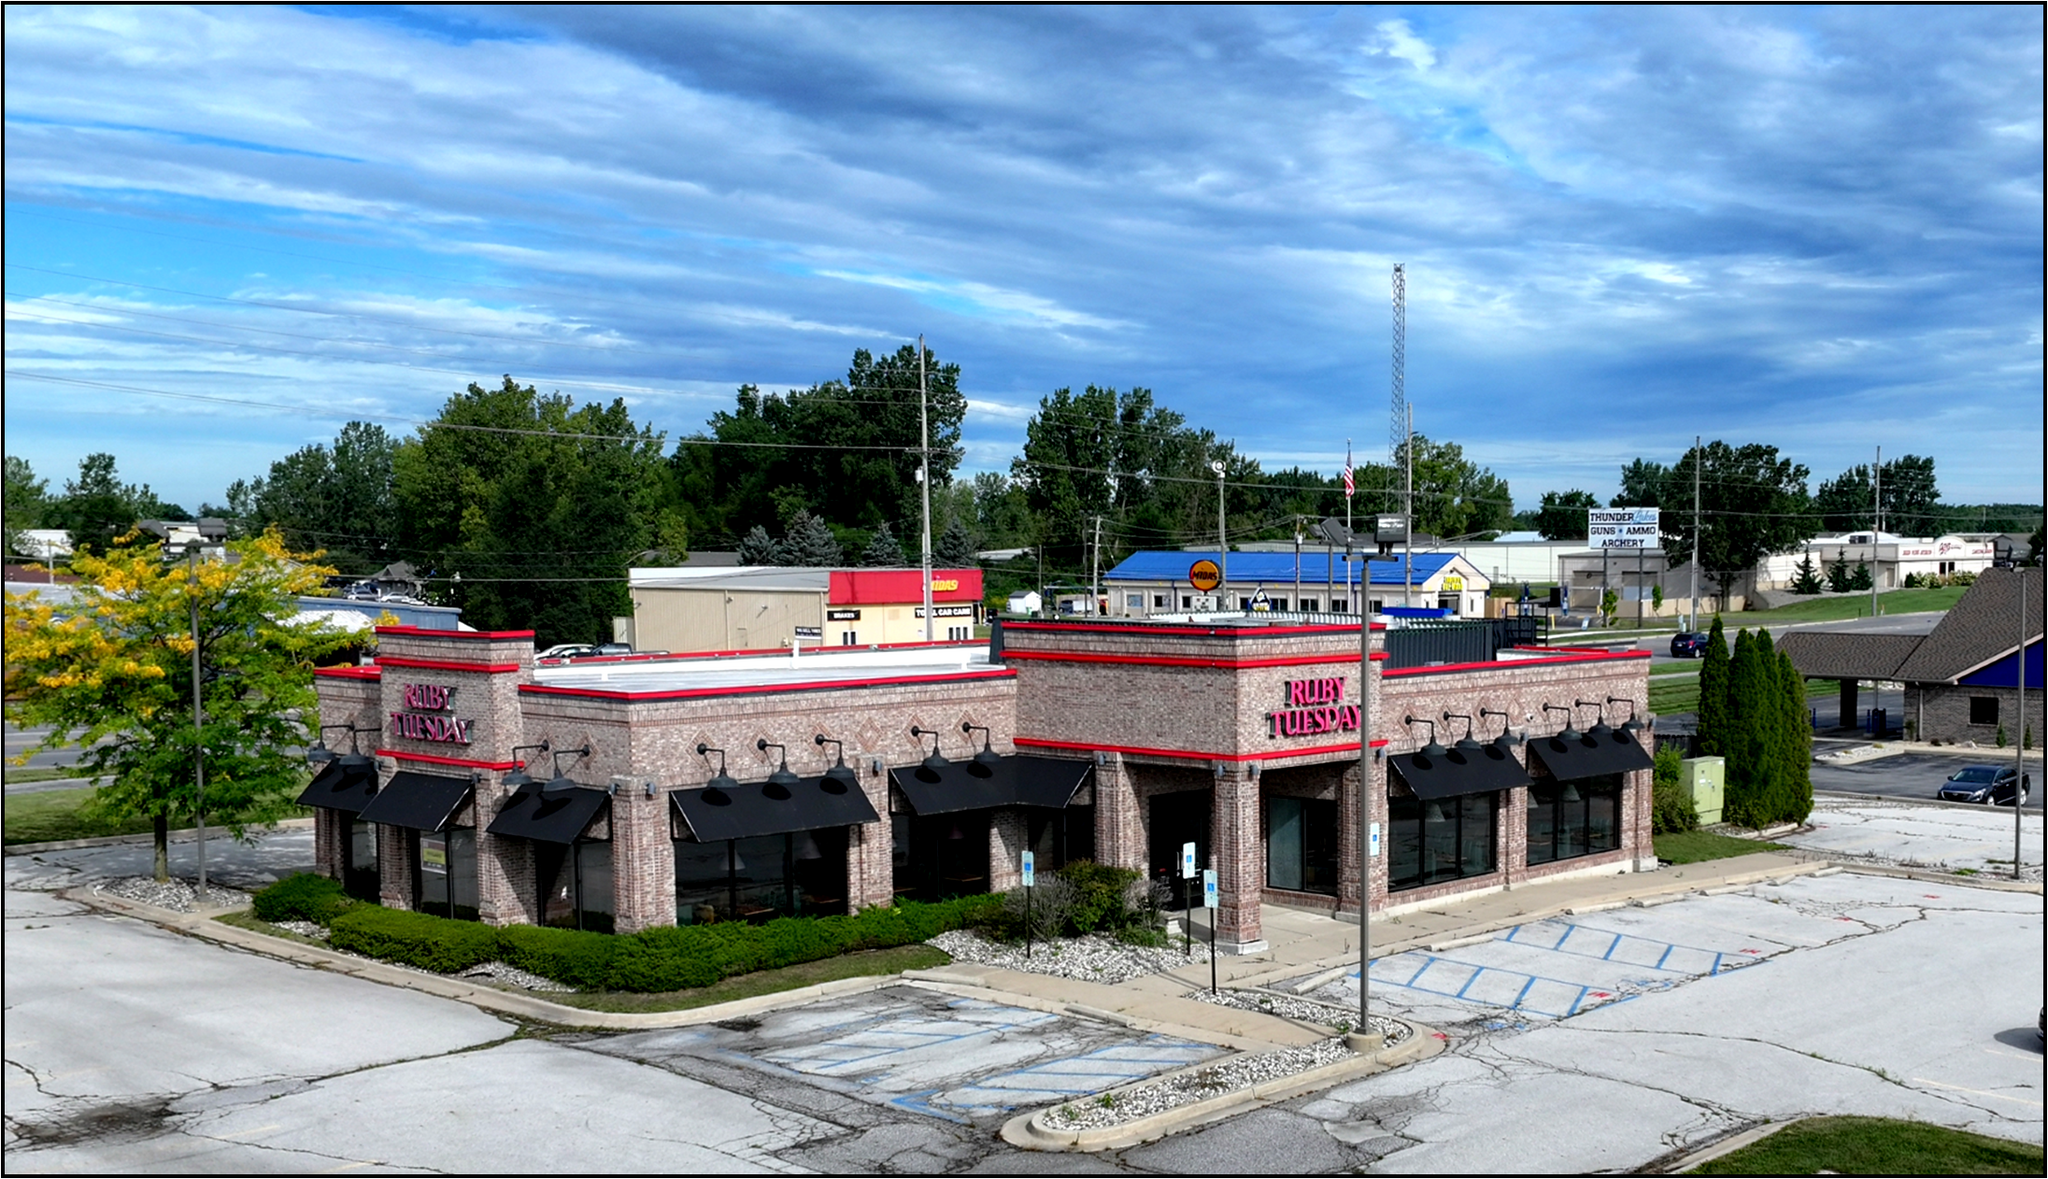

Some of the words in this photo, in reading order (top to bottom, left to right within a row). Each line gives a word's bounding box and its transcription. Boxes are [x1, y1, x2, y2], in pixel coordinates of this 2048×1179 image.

[1590, 513, 1634, 522] THUNDER
[1590, 527, 1616, 535] GUNS
[1626, 527, 1656, 535] AMMO
[1602, 539, 1645, 547] ARCHERY
[1193, 571, 1218, 580] MIDAS
[922, 579, 959, 592] IDAS
[938, 608, 952, 616] CAR
[953, 607, 971, 615] CARE
[404, 683, 457, 711] RUBY
[1285, 676, 1348, 708] RUBY
[390, 711, 475, 744] TUESDAY
[1266, 705, 1362, 739] TUESDAY
